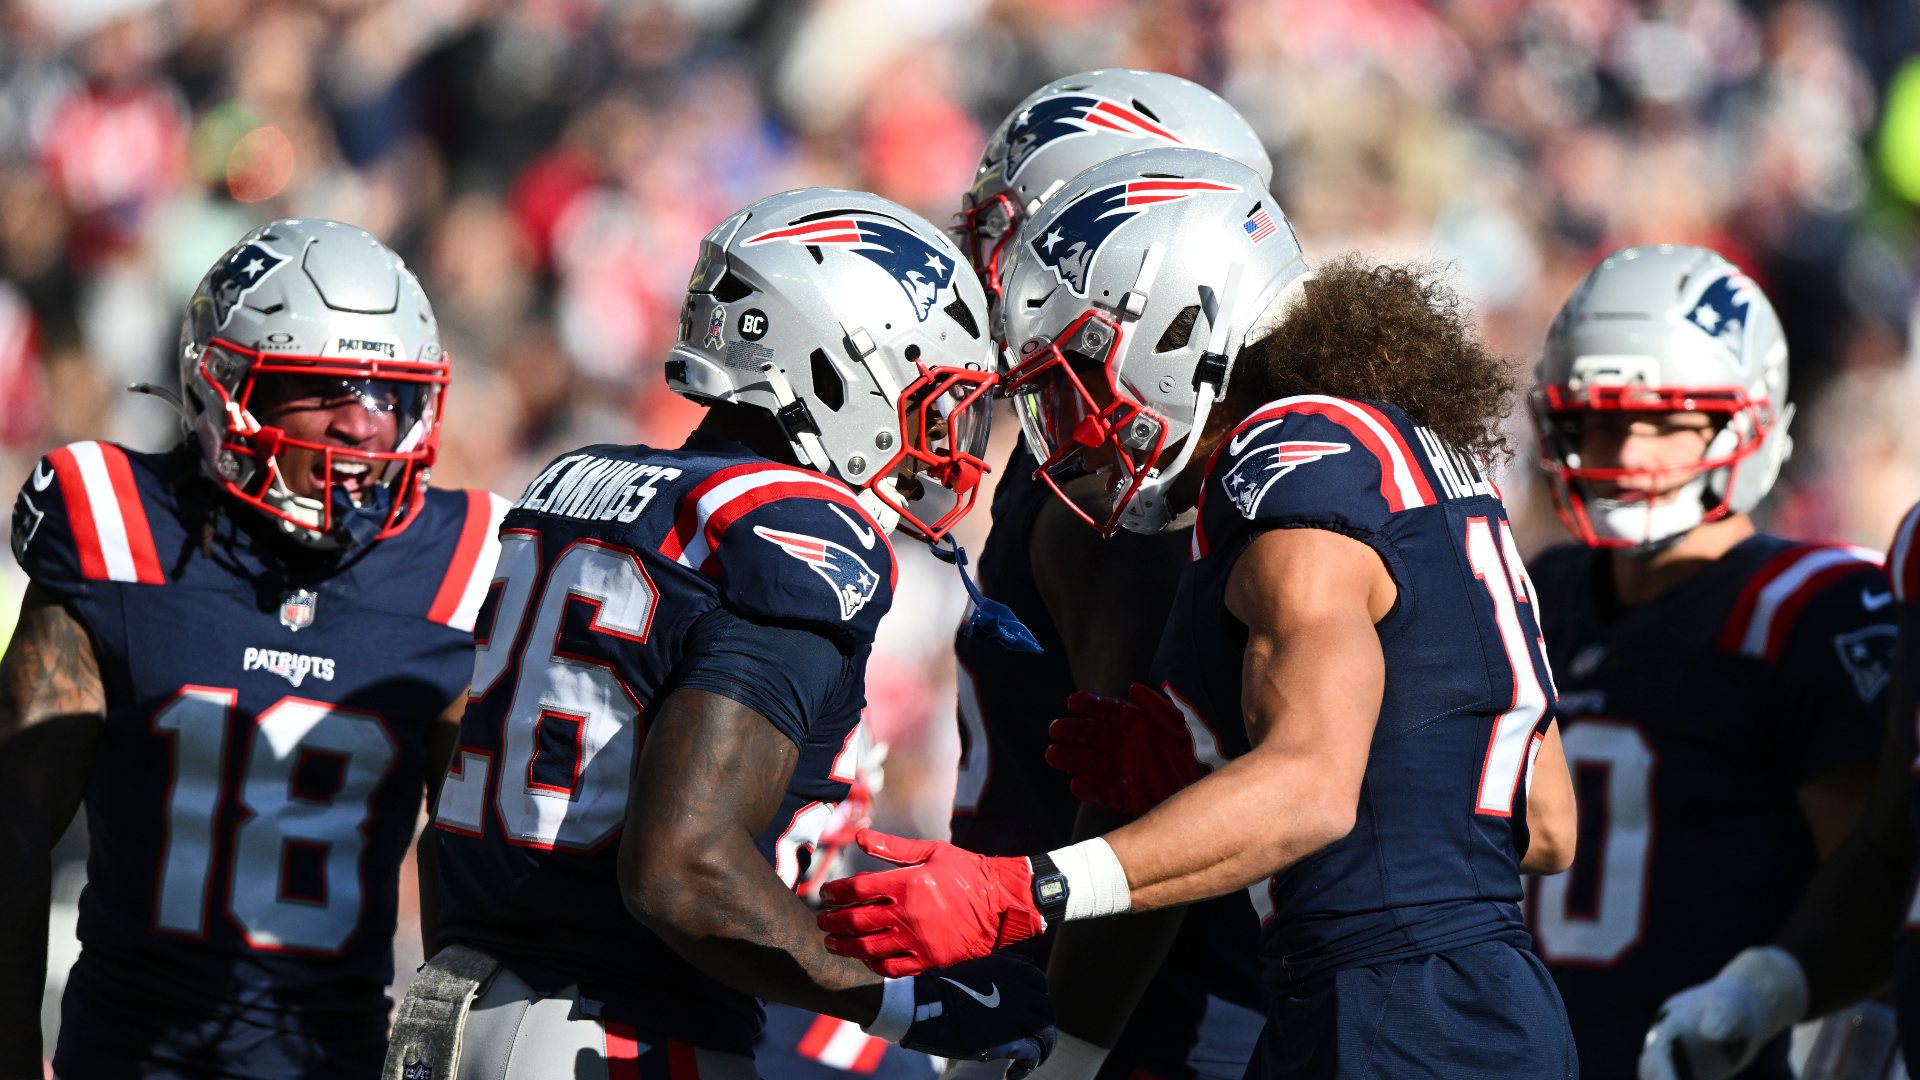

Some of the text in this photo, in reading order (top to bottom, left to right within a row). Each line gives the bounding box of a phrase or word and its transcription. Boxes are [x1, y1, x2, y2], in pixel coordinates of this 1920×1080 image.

[338, 338, 395, 359] PATRIOTS
[742, 314, 764, 334] BC
[511, 454, 683, 524] JENNINGS
[243, 647, 335, 682] PATRIOTS
[434, 528, 660, 853] 26
[152, 684, 398, 955] 18
